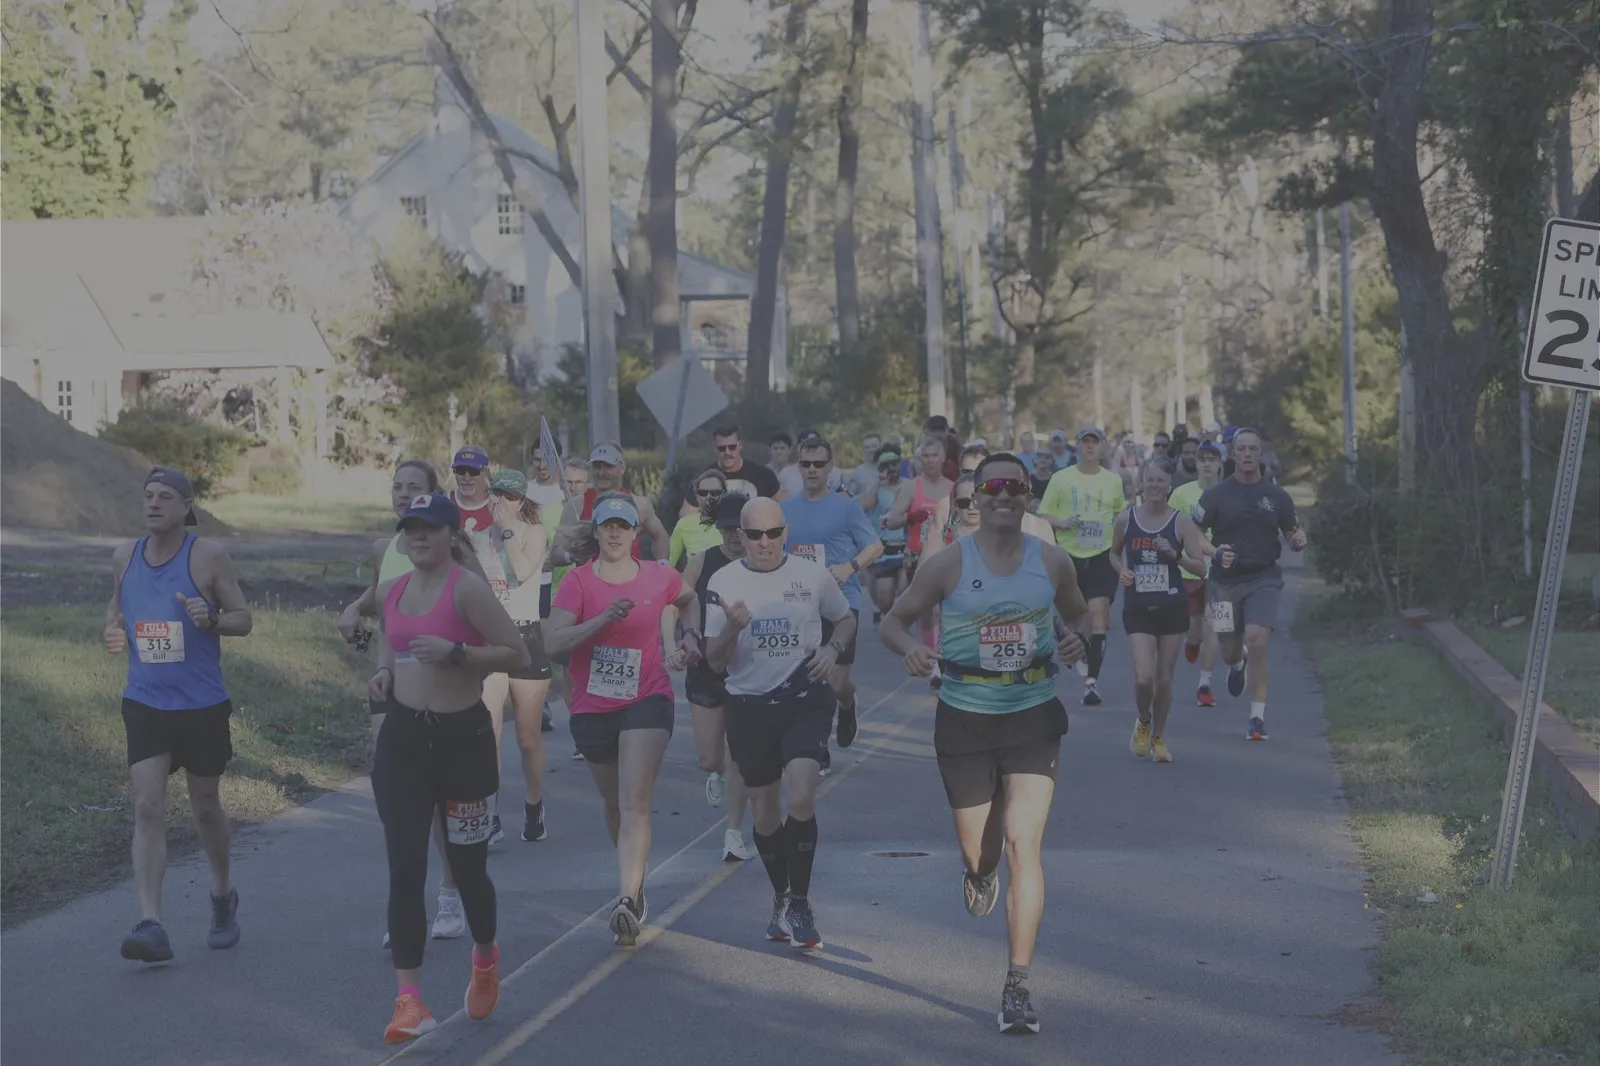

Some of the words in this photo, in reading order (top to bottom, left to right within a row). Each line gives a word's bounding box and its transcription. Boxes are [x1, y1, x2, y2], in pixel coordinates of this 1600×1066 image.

[1537, 309, 1600, 371] 2
[1139, 574, 1165, 584] 2273
[143, 623, 167, 632] FULL
[760, 619, 788, 629] HALF
[990, 624, 1020, 636] FULL
[758, 634, 799, 649] 2093
[981, 633, 1020, 642] MARATHON
[147, 638, 171, 650] 313
[153, 652, 166, 660] Bill
[600, 647, 627, 658] HALF
[768, 649, 790, 658] Dave
[993, 643, 1027, 658] 265
[595, 661, 635, 678] 2243
[997, 660, 1022, 668] Scott
[602, 676, 625, 686] Sarah
[457, 800, 486, 812] FULL
[458, 814, 489, 832] 294
